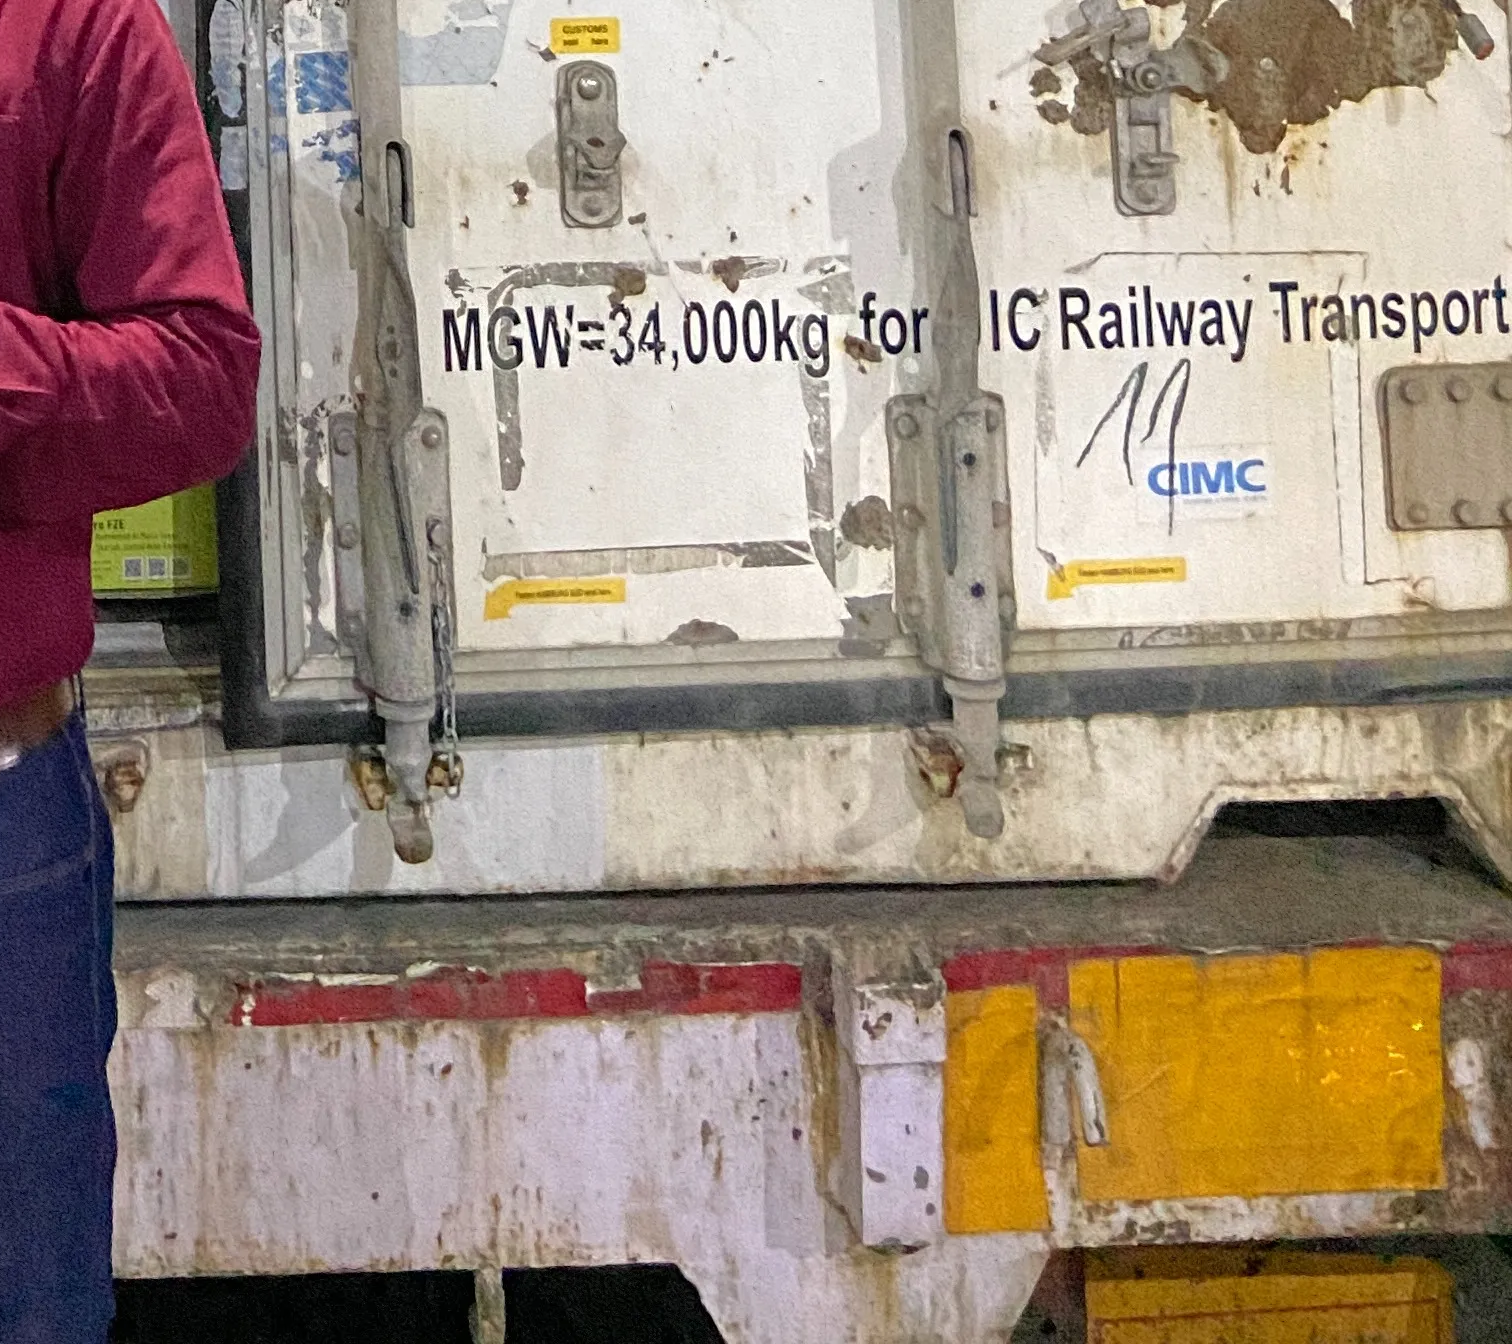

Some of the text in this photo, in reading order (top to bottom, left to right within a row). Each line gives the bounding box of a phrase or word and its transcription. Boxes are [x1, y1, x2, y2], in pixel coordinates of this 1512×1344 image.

[563, 25, 608, 33] CUSTOMS
[443, 279, 1509, 379] MGW=34,000kg for IC Railway Transport
[1148, 460, 1266, 496] CIMC
[107, 519, 125, 530] FZE
